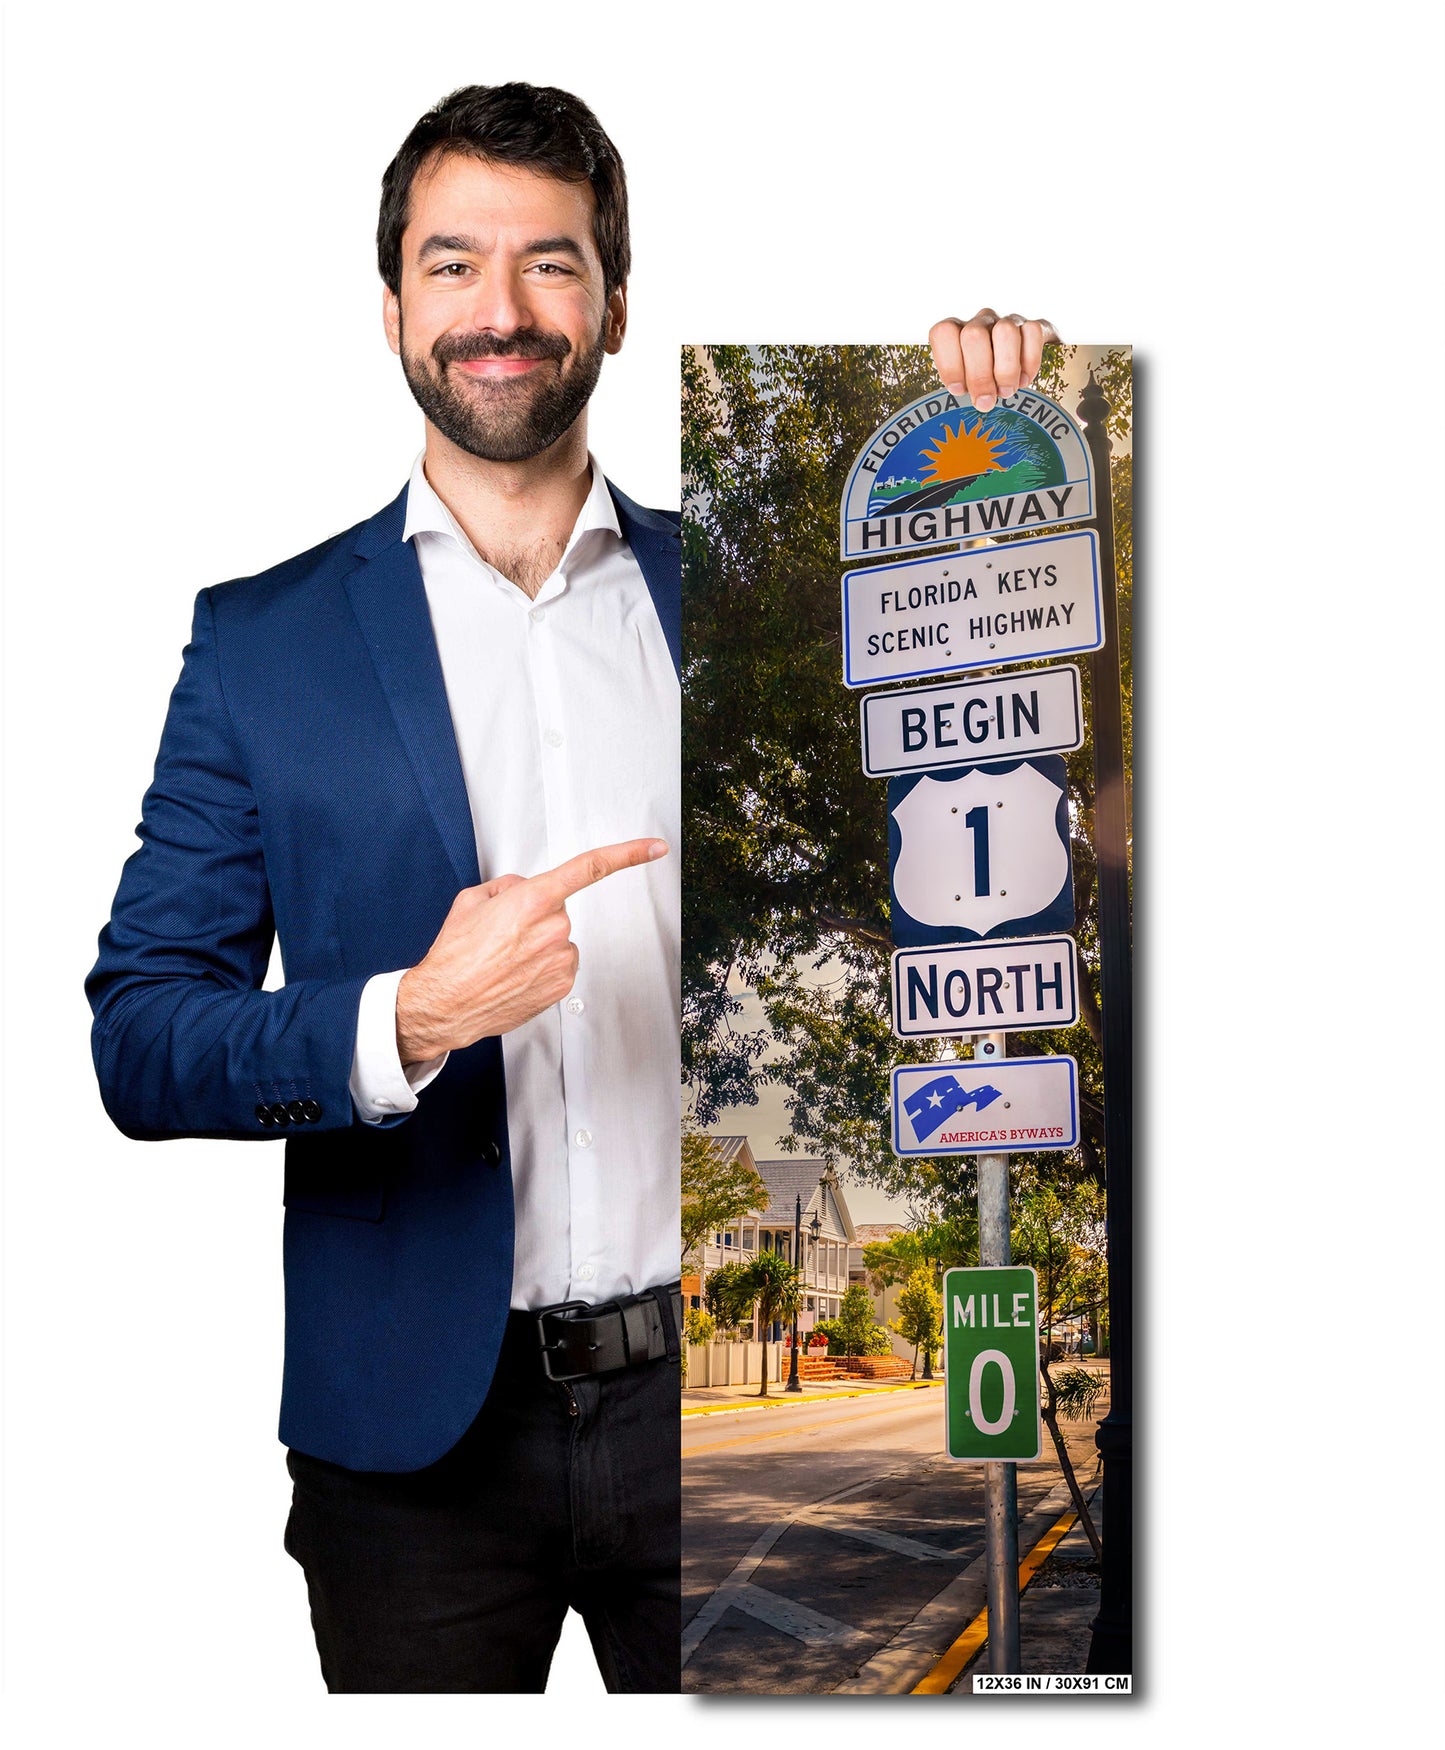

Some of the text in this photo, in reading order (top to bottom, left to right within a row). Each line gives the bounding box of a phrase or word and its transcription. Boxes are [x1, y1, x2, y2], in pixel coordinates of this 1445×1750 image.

[862, 393, 1070, 474] FLORIDA CENIC
[862, 486, 1074, 550] HIGHWAY
[881, 564, 1058, 614] FLORIDA KEYS
[867, 602, 1075, 656] SCENIC HIGHWAY
[901, 690, 1041, 753] BEGIN
[965, 805, 991, 898] 1
[907, 961, 1064, 1021] NORTH
[939, 1127, 1064, 1143] AMERICA'S BYWAYS
[953, 1293, 1031, 1328] MILE
[968, 1349, 1016, 1436] 0
